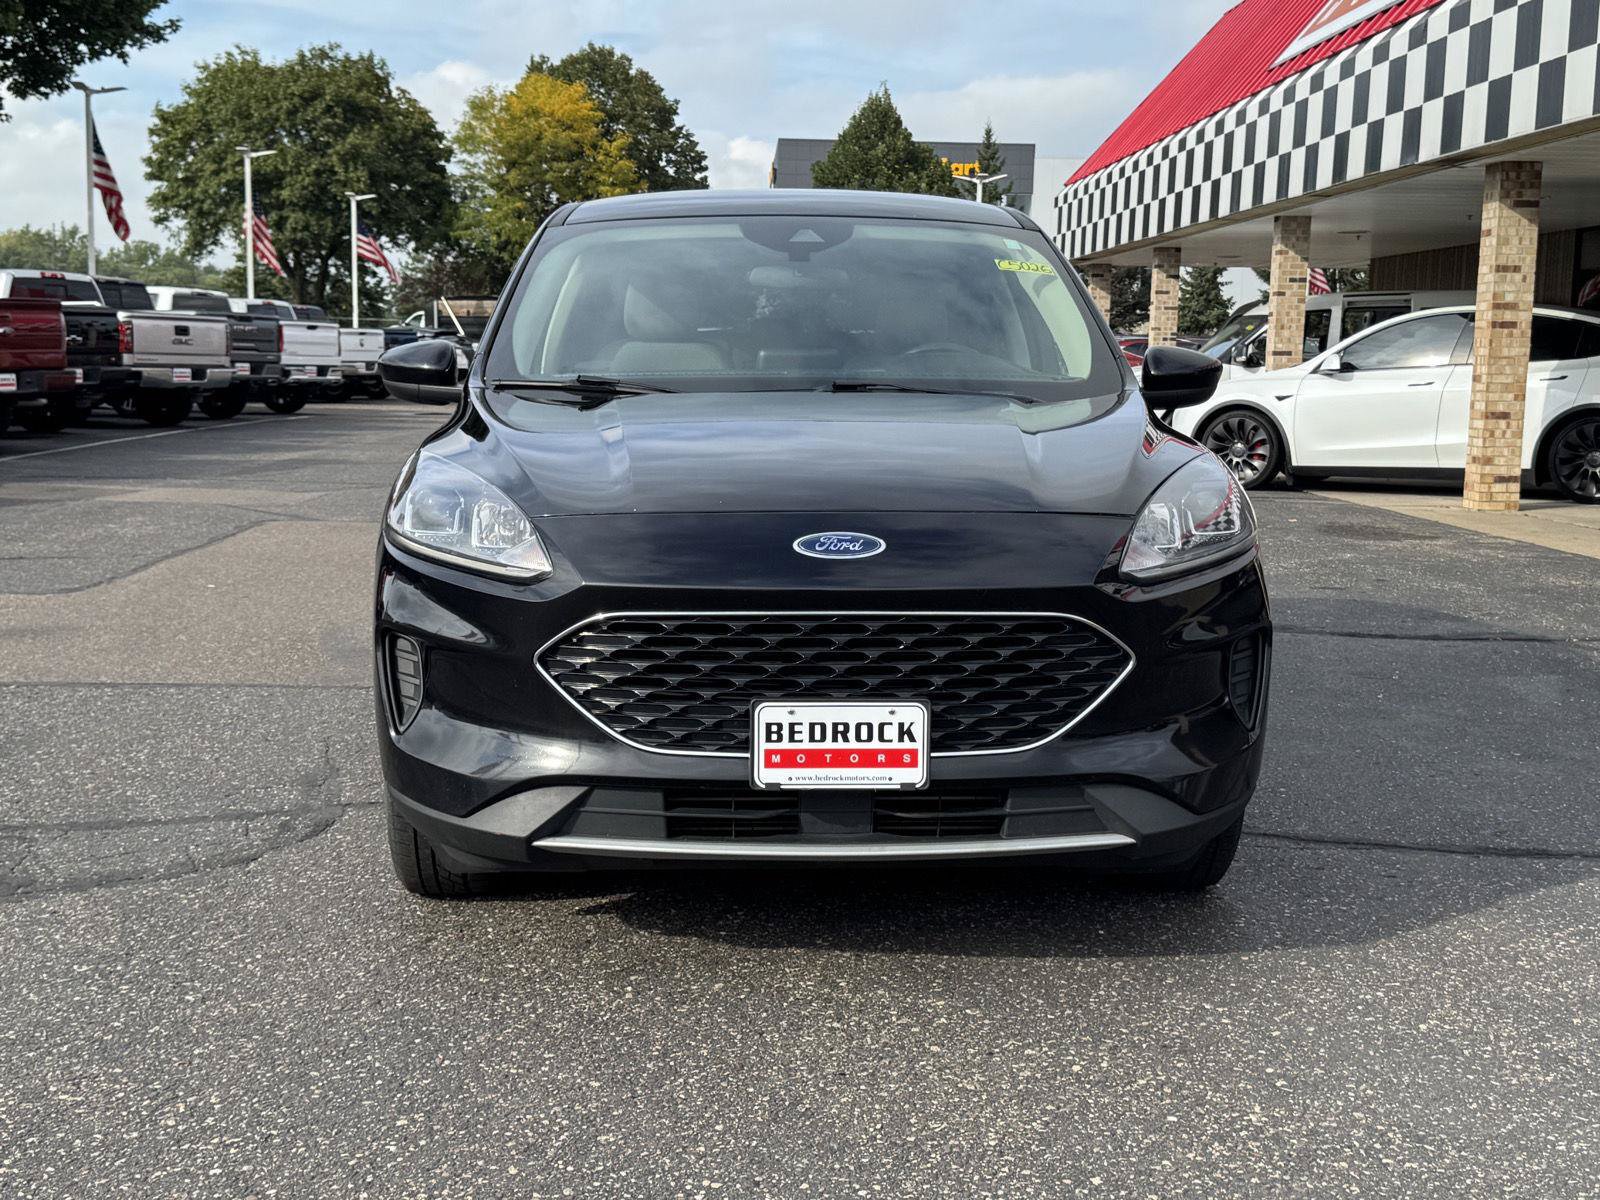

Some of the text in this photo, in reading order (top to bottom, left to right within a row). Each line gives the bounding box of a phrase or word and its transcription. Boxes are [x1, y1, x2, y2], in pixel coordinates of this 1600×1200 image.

[815, 535, 864, 551] Ford
[765, 721, 917, 743] BEDROCK
[771, 753, 911, 764] MOTORS
[795, 774, 887, 782] www.bedrockmotors.com
